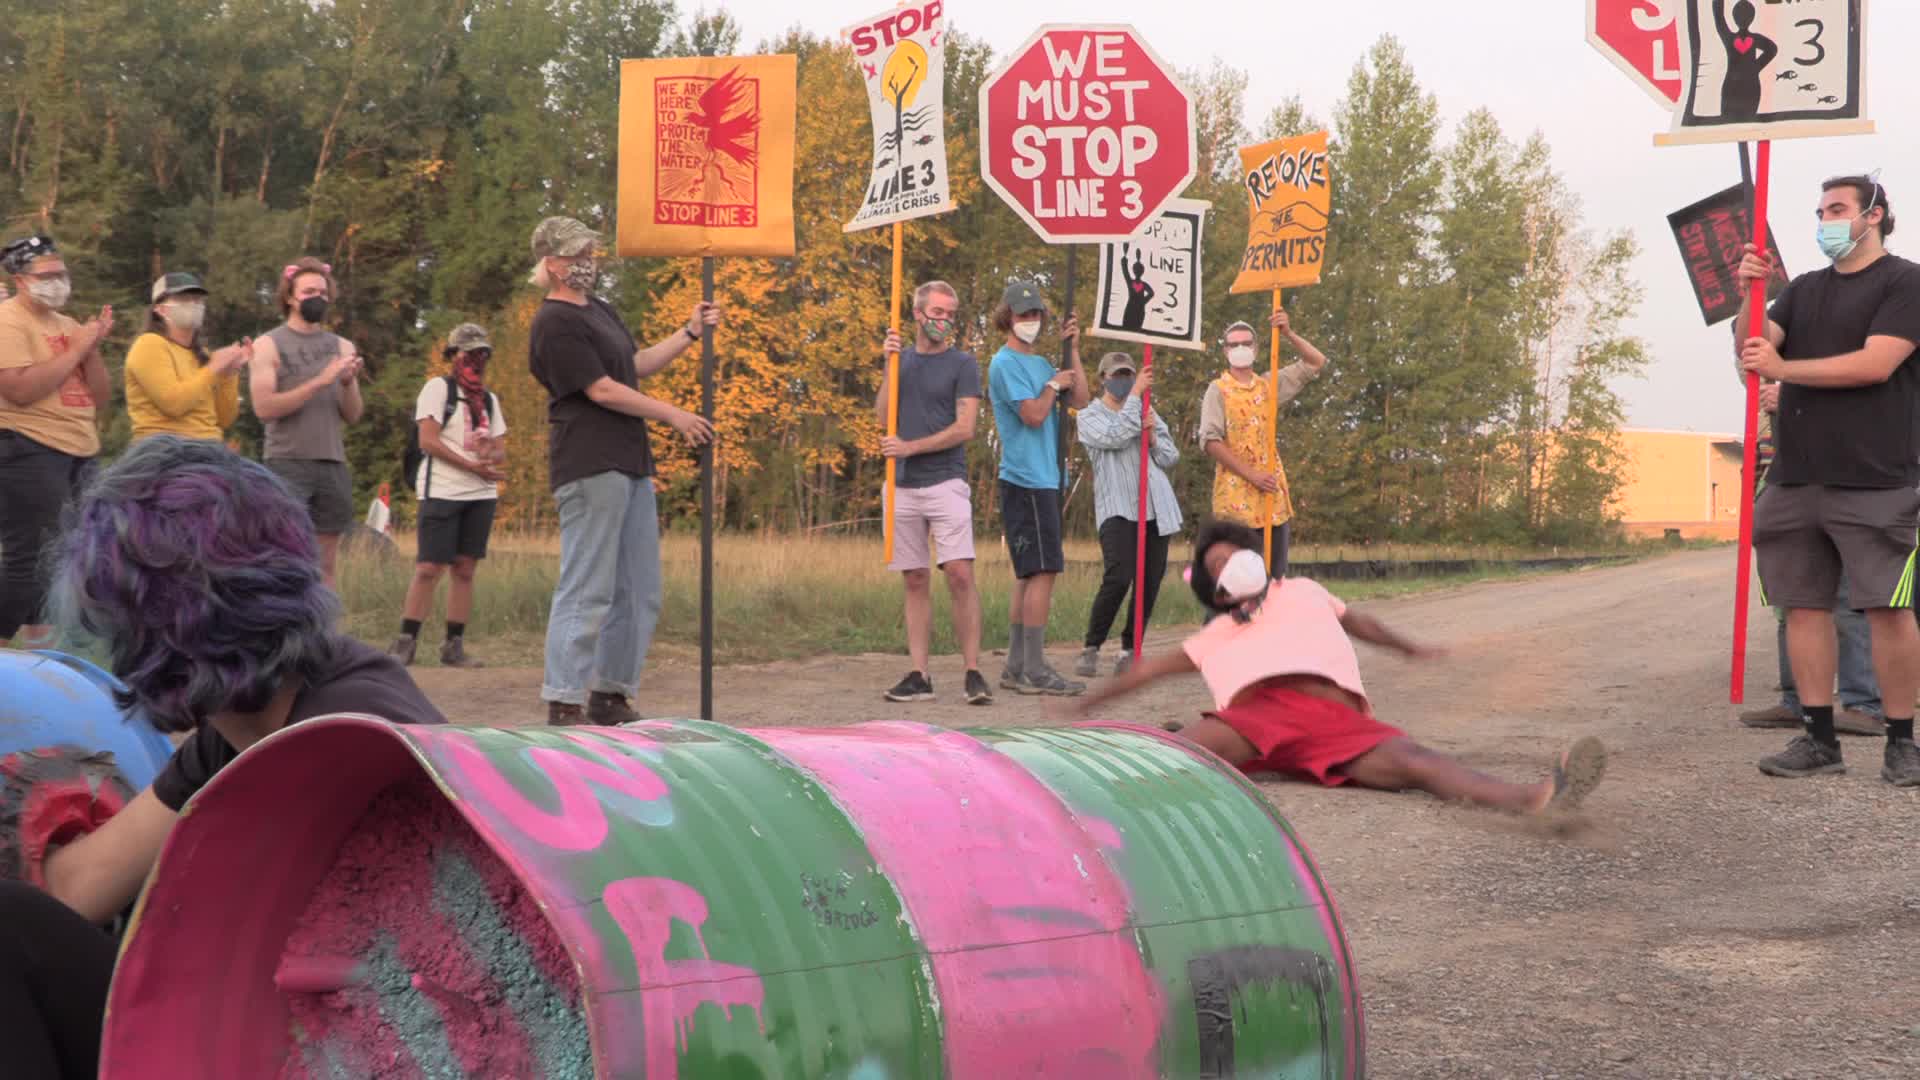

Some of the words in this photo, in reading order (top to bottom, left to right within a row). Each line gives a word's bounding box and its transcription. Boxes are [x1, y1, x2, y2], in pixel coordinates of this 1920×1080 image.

[851, 0, 944, 57] STOP
[1793, 18, 1825, 66] 3
[1042, 34, 1127, 78] WE
[659, 83, 676, 96] WE
[684, 83, 704, 96] ARE
[1017, 80, 1149, 121] MUST
[659, 97, 693, 109] HERE
[659, 110, 677, 121] TO
[659, 125, 709, 141] PROTECT
[660, 139, 684, 153] THE
[660, 154, 702, 169] WATER
[1011, 125, 1158, 179] STOP
[921, 159, 935, 187] 3
[1246, 148, 1326, 210] REVOKE
[902, 193, 941, 211] CRISIS
[1033, 179, 1107, 218] LINE
[1119, 180, 1144, 219] 3
[658, 202, 701, 222] STOP
[705, 206, 738, 225] LINE
[743, 208, 755, 225] 3
[1150, 251, 1184, 273] LINE
[1242, 236, 1324, 272] PERMITS
[1163, 282, 1178, 308] 3
